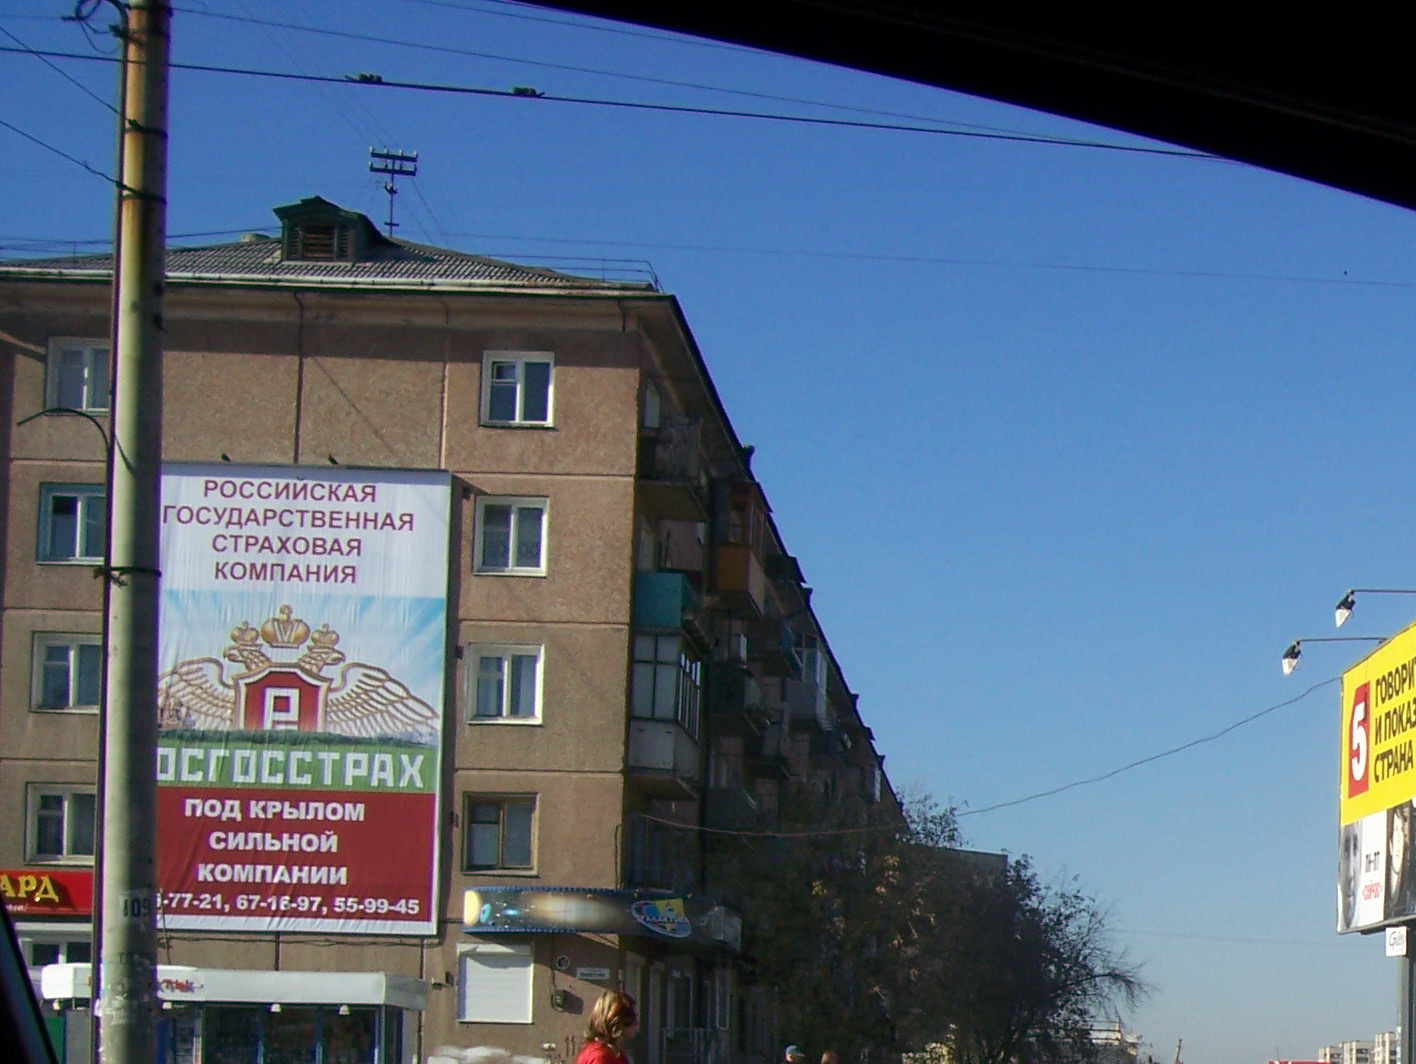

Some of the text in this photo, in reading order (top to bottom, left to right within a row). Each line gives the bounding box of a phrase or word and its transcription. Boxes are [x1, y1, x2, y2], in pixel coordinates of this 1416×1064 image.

[203, 478, 378, 503] РОССИЙСКАЯ
[163, 504, 415, 532] ГОСУДАРСТВЕННАЯ
[212, 533, 363, 557] СТРАХОВАЯ
[214, 561, 357, 585] КОМПАНИЯ
[157, 746, 425, 788] ОСГОССТРАХ
[1373, 739, 1414, 784] СТРАНА
[184, 797, 366, 822] ПОД КРЫЛОМ
[209, 828, 339, 854] СИЛЬНОЙ
[197, 861, 348, 886] КОМПАНИИ
[334, 896, 421, 915] 55-99-45
